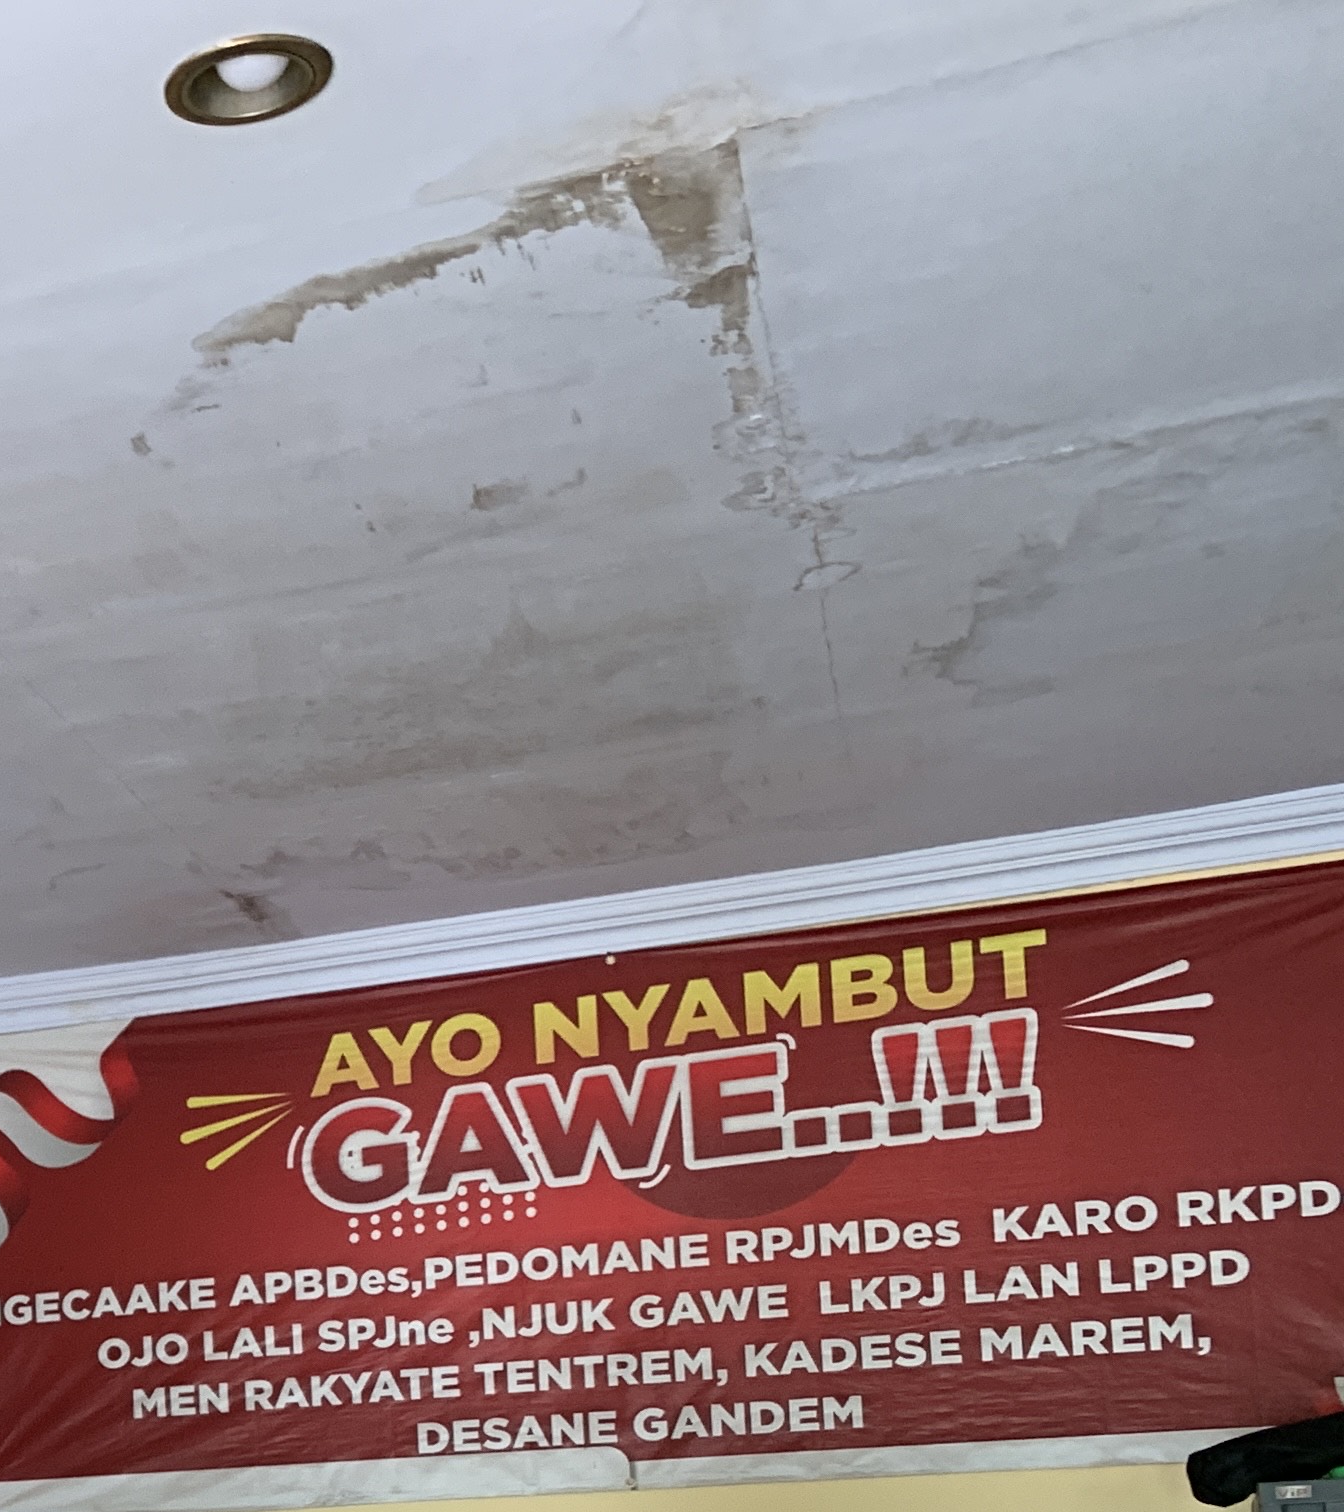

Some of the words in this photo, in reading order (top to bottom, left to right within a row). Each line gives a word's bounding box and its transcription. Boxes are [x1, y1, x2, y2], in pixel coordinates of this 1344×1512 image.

[311, 1013, 501, 1099] AYO
[533, 928, 1048, 1065] NYAMBUT
[725, 1217, 961, 1266] RPJMDes
[992, 1194, 1159, 1243] KARO
[1177, 1180, 1341, 1229] RKPD
[97, 1334, 189, 1369] OJO
[203, 1322, 304, 1362] LALI
[317, 1311, 454, 1353] SPJne
[629, 1283, 789, 1330] GAWE
[819, 1270, 947, 1316] LKPJ
[964, 1260, 1080, 1306] LAN
[1099, 1249, 1251, 1295] LPPD
[132, 1381, 230, 1419] MEN
[244, 1365, 461, 1411] RAKYATE
[473, 1348, 729, 1396] TENTREM,
[744, 1329, 963, 1378] KADESE
[980, 1313, 1212, 1363] MAREM,
[416, 1410, 619, 1455] DESANE
[631, 1395, 864, 1443] GANDEM
